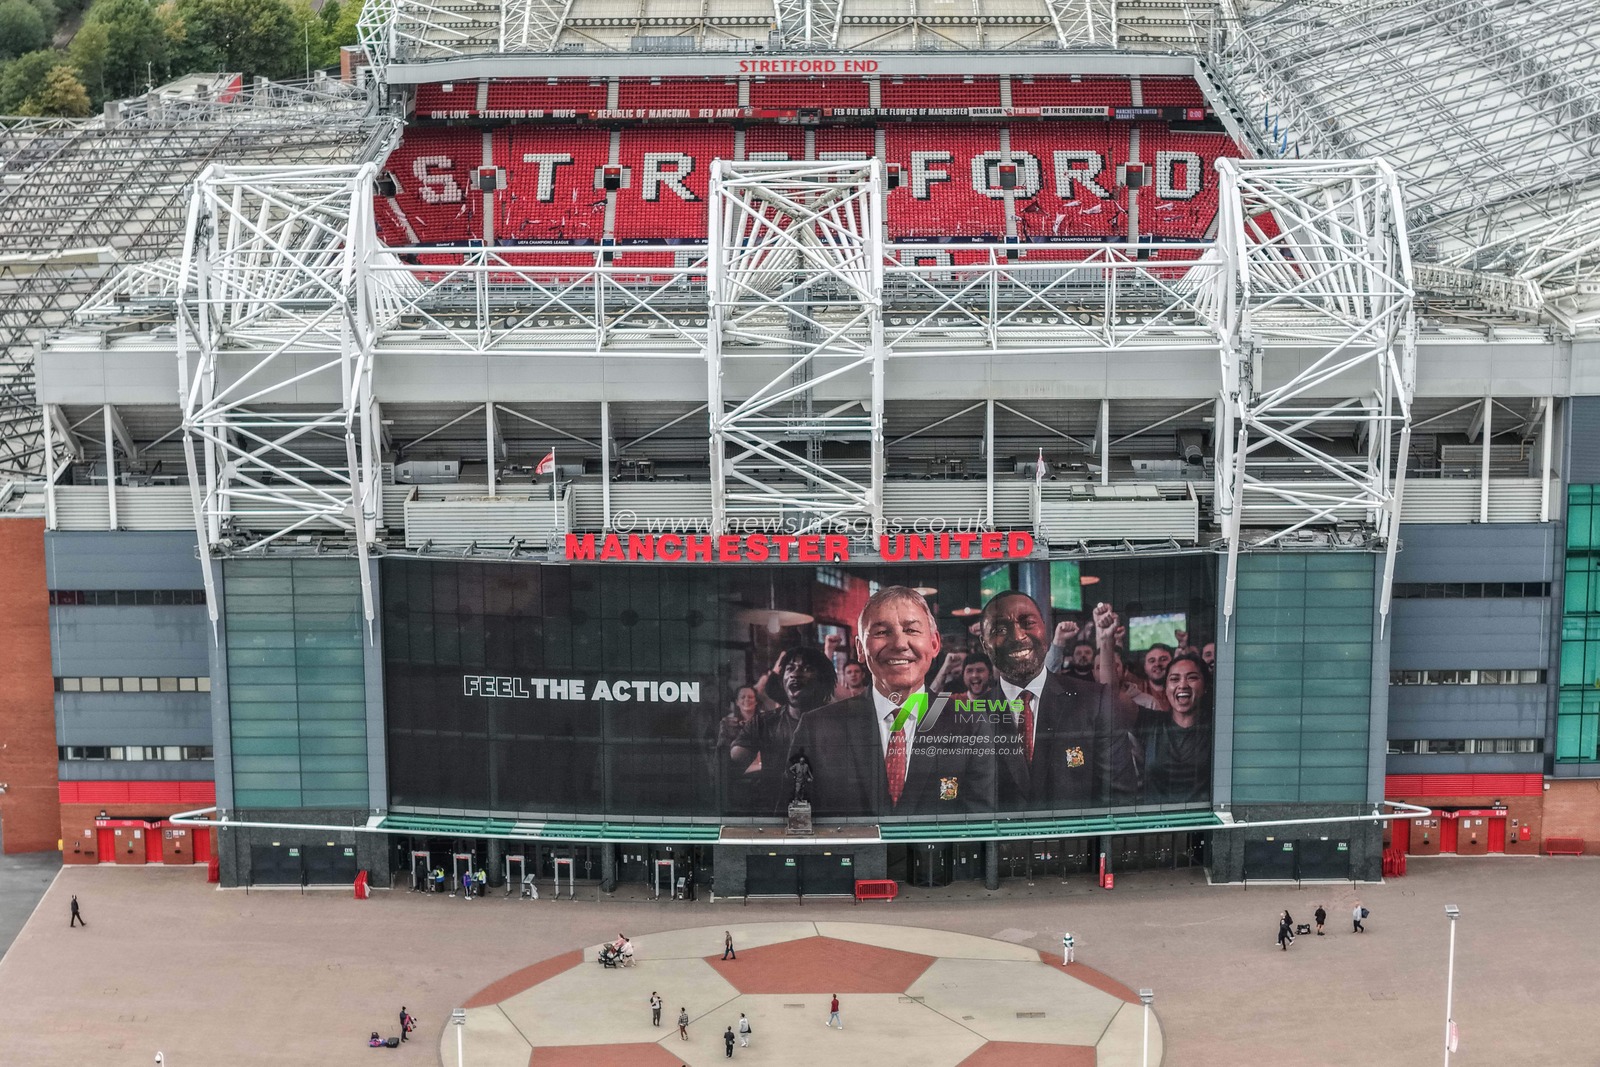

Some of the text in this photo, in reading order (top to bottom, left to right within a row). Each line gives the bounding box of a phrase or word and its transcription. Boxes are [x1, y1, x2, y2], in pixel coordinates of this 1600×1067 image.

[739, 60, 878, 72] STRETFORD END
[431, 110, 470, 119] ONE LOVE
[478, 109, 576, 119] STRETFORD END MUFC
[636, 108, 647, 118] OF
[834, 108, 845, 116] FEB
[876, 108, 888, 116] THE
[889, 108, 918, 116] FLOWERS
[919, 108, 927, 116] OF
[413, 150, 1204, 203] STRFORD
[565, 531, 1034, 563] MANCHESTER UNITED
[463, 674, 700, 702] FEEL THE ACTION
